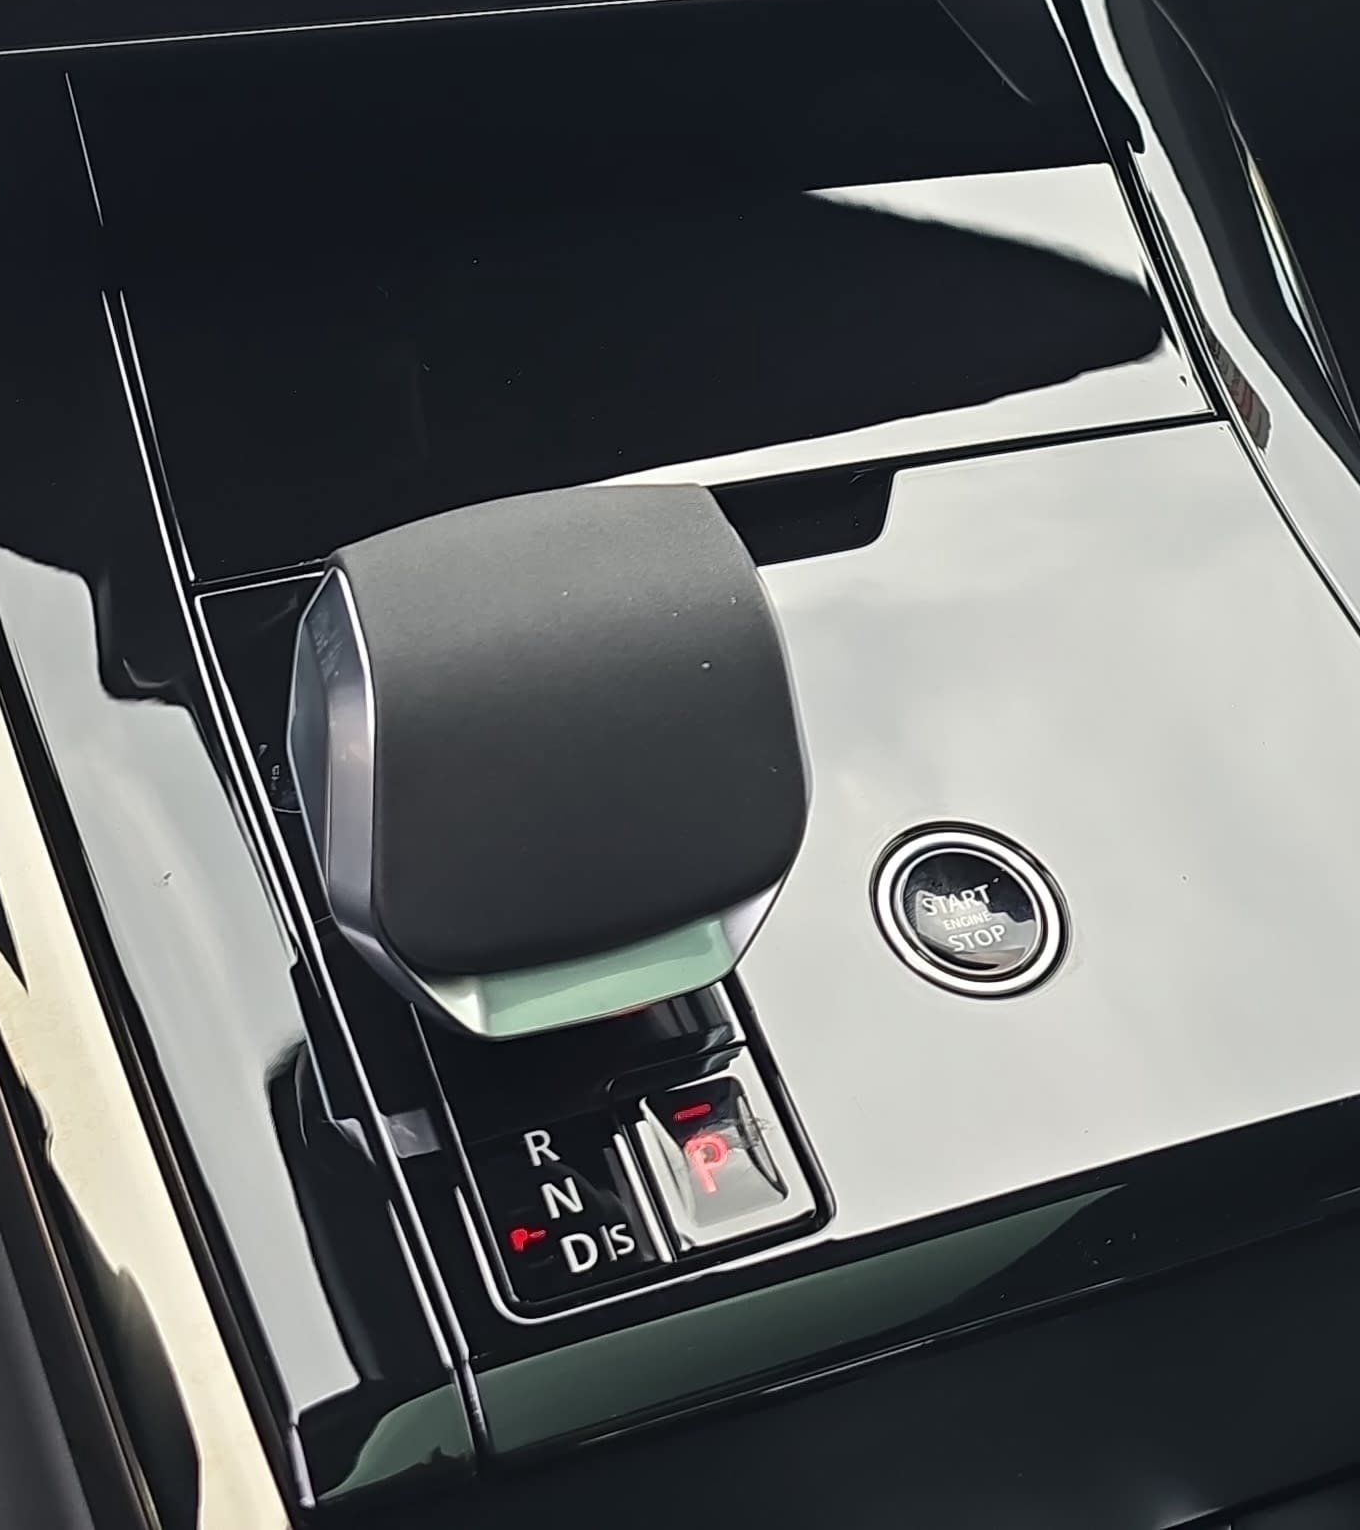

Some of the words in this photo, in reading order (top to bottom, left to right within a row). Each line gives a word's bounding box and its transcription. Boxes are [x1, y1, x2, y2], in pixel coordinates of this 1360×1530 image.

[922, 884, 992, 916] START
[942, 910, 992, 931] ENGINE
[947, 924, 1006, 952] STOP
[523, 1129, 561, 1167] R
[683, 1134, 728, 1193] P
[540, 1176, 584, 1219] N
